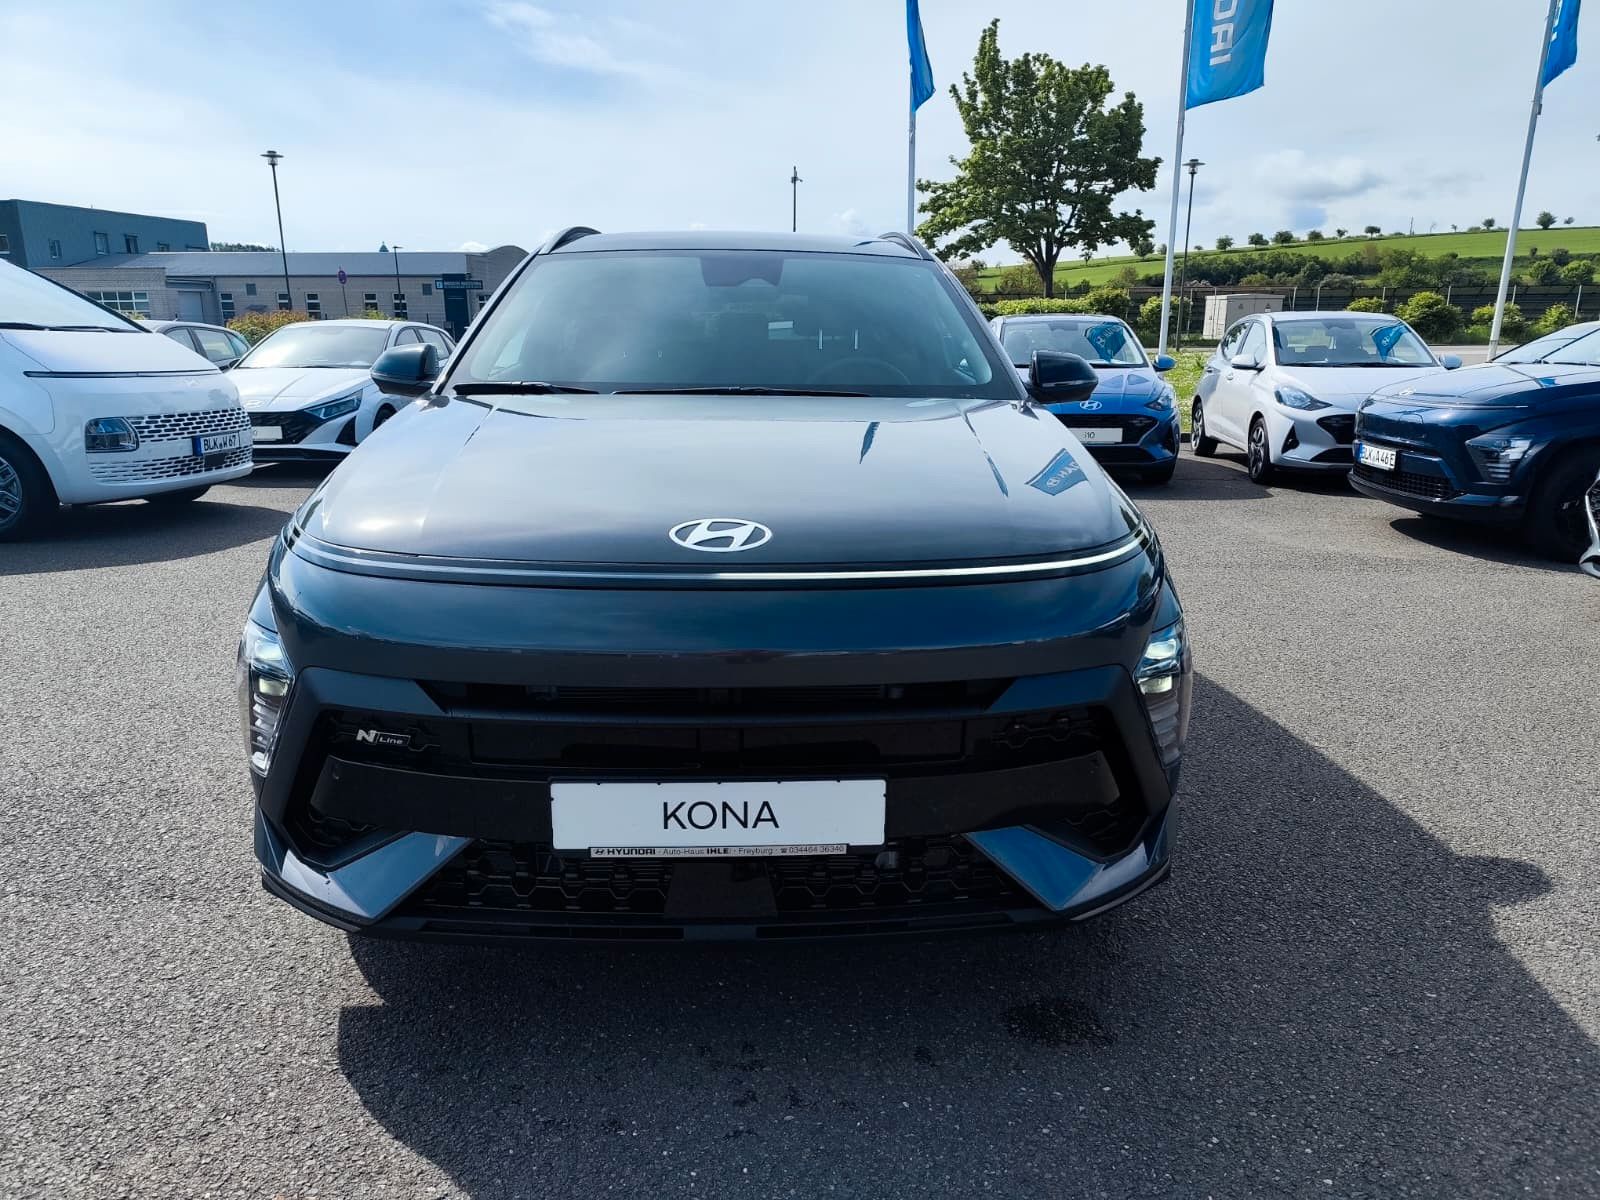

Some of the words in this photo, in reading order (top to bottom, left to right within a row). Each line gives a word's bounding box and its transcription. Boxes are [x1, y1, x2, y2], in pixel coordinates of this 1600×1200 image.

[203, 437, 219, 451] BLK
[663, 801, 779, 830] KONA
[607, 848, 656, 856] HYUNDAI
[738, 847, 773, 856] Freyburg
